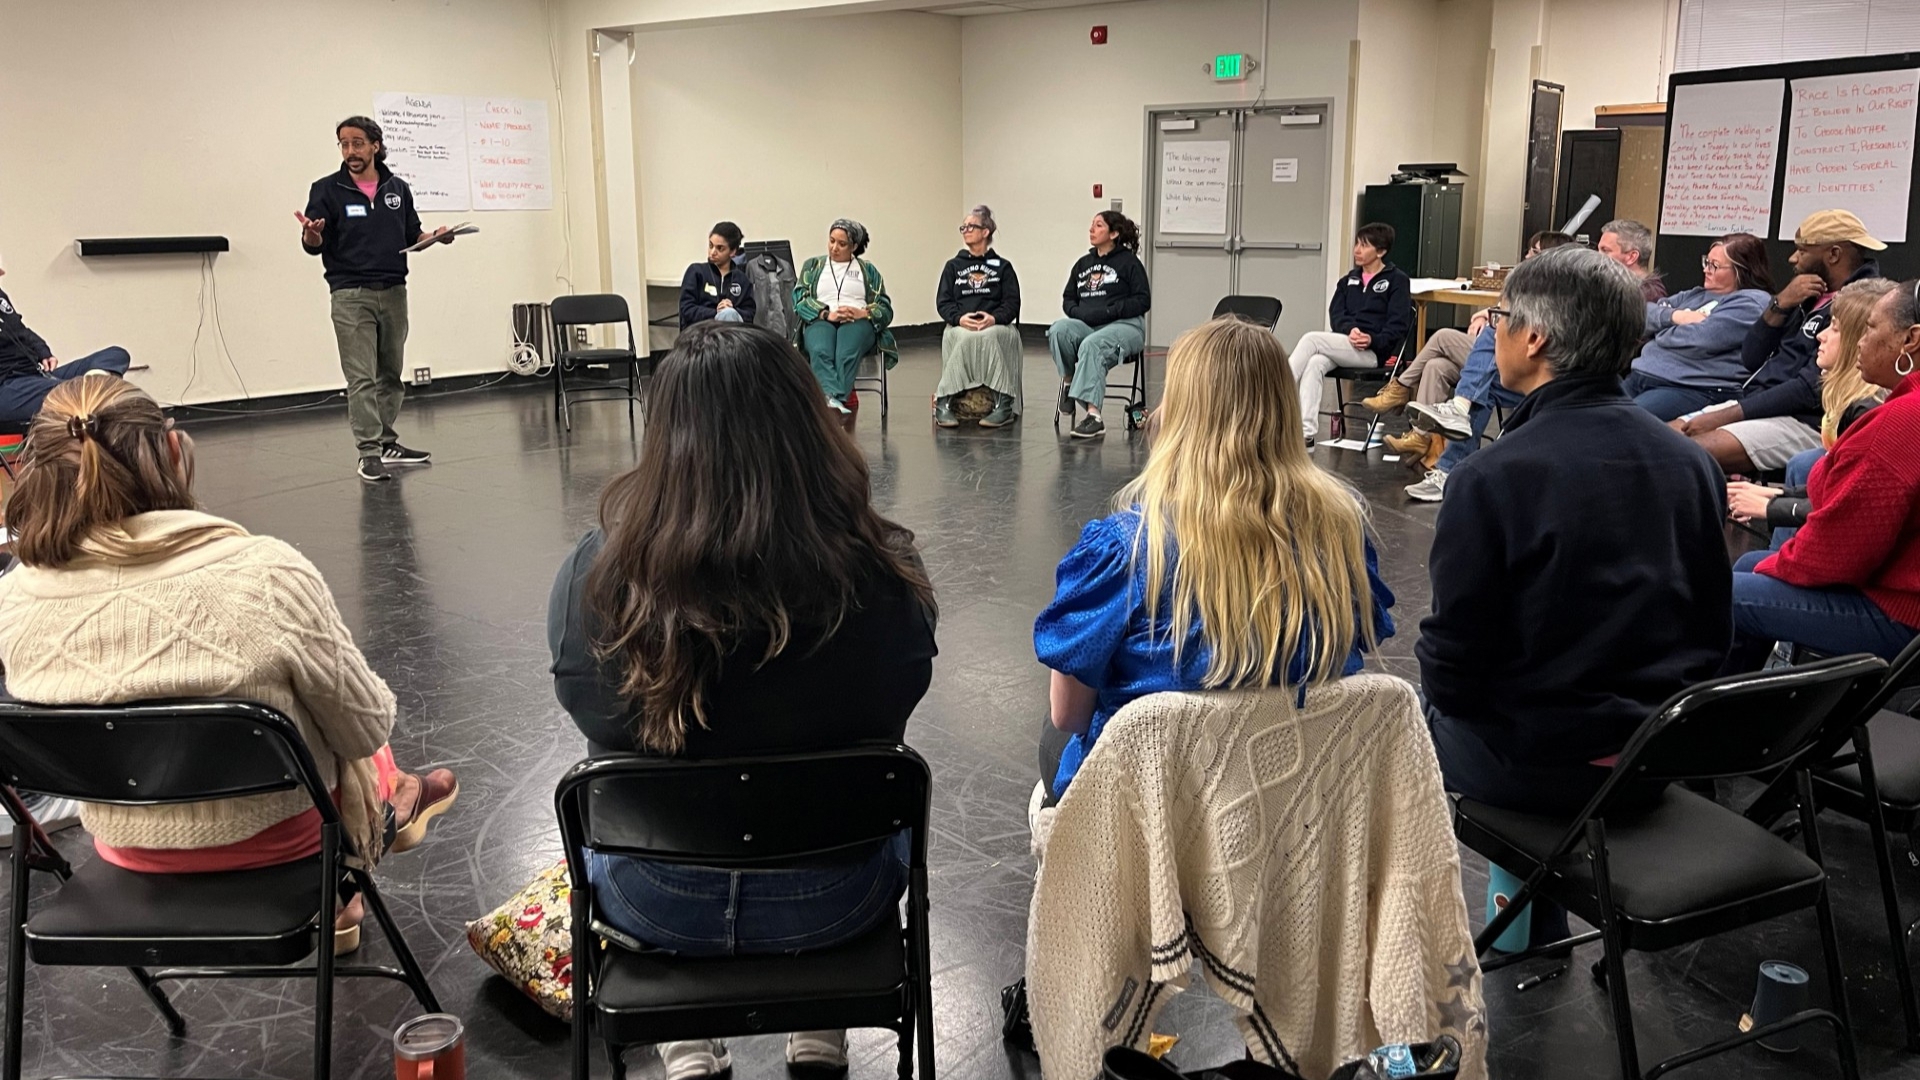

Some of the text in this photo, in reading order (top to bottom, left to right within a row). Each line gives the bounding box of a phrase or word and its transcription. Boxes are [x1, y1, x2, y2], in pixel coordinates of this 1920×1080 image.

[1216, 54, 1241, 77] EXIT
[1837, 86, 1847, 97] IS
[1852, 84, 1858, 96] A
[1863, 83, 1914, 95] CONSTRUCT
[405, 96, 432, 108] AGENDA
[1797, 98, 1913, 118] I BELIEVE IN OUR RIGHT
[480, 122, 500, 130] NAME
[1795, 124, 1887, 138] TO CHOOSE ANOTHER
[1698, 127, 1730, 142] complete
[1765, 126, 1774, 134] of
[1671, 141, 1697, 156] Comedy
[1793, 145, 1845, 156] CONSTRUCT
[1861, 140, 1909, 151] PERSONALLY,
[1712, 154, 1730, 164] every
[1757, 151, 1770, 162] day
[1756, 161, 1769, 170] that
[1790, 160, 1898, 176] HAVE CHOSEN SEVERAL
[1735, 182, 1743, 190] all
[1788, 184, 1811, 194] RACE
[1720, 193, 1748, 203] something
[957, 265, 979, 277] CAMINO
[1078, 264, 1101, 278] CAMINO
